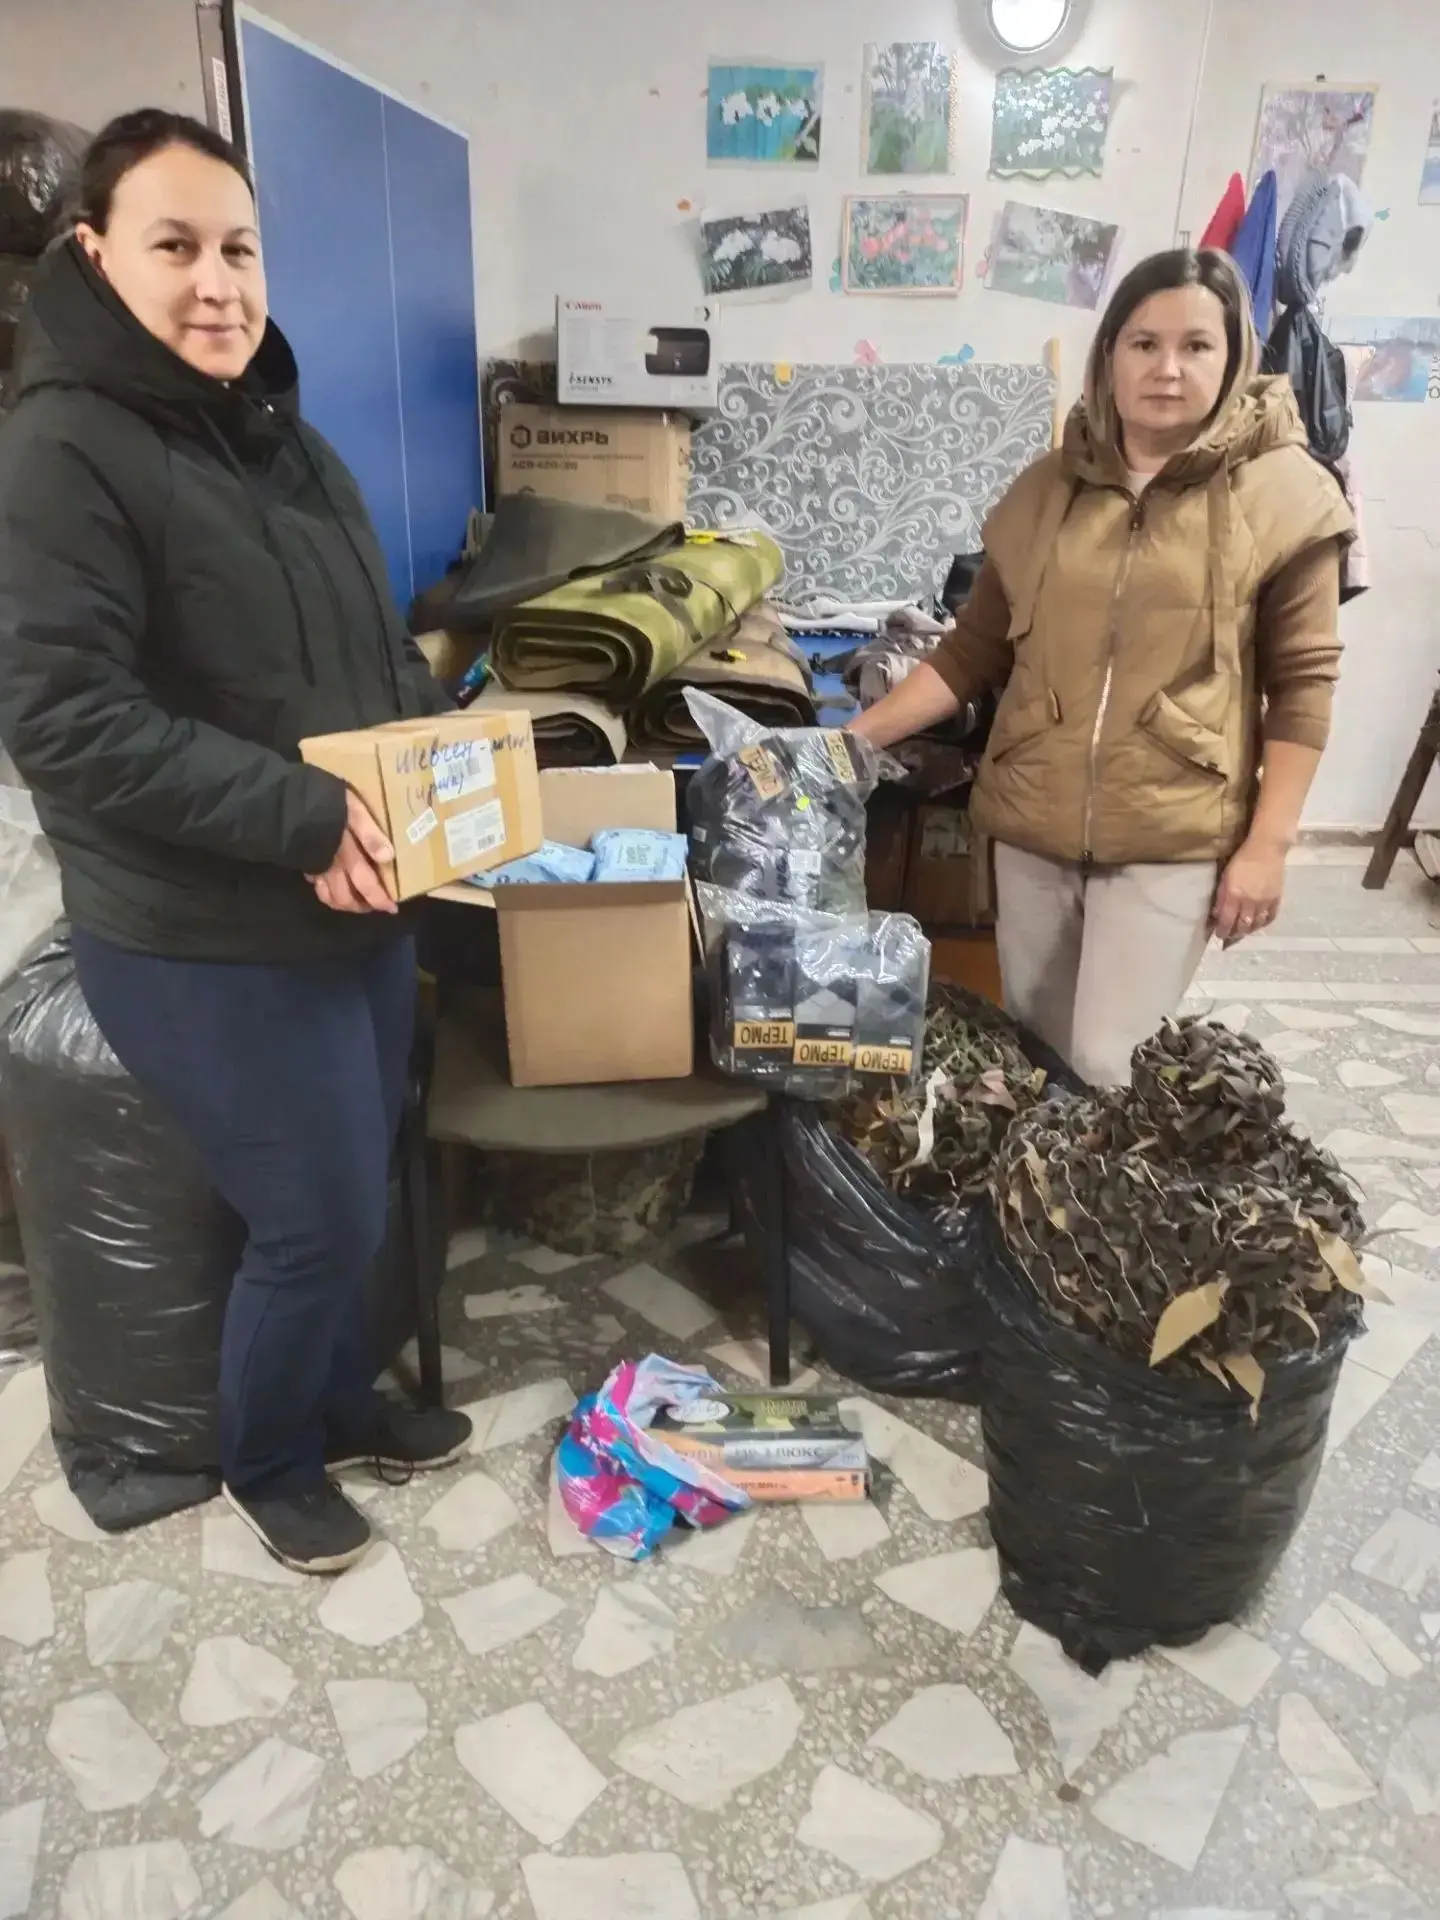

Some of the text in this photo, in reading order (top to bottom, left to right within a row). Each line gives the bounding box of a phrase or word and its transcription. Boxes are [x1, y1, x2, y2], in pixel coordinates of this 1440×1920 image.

[566, 301, 602, 312] Canon
[536, 429, 609, 446] ВИХРЬ
[739, 1026, 788, 1044] ТЕРМО
[799, 1043, 846, 1062] ТЕРМО
[861, 1050, 906, 1068] ТЕРМО
